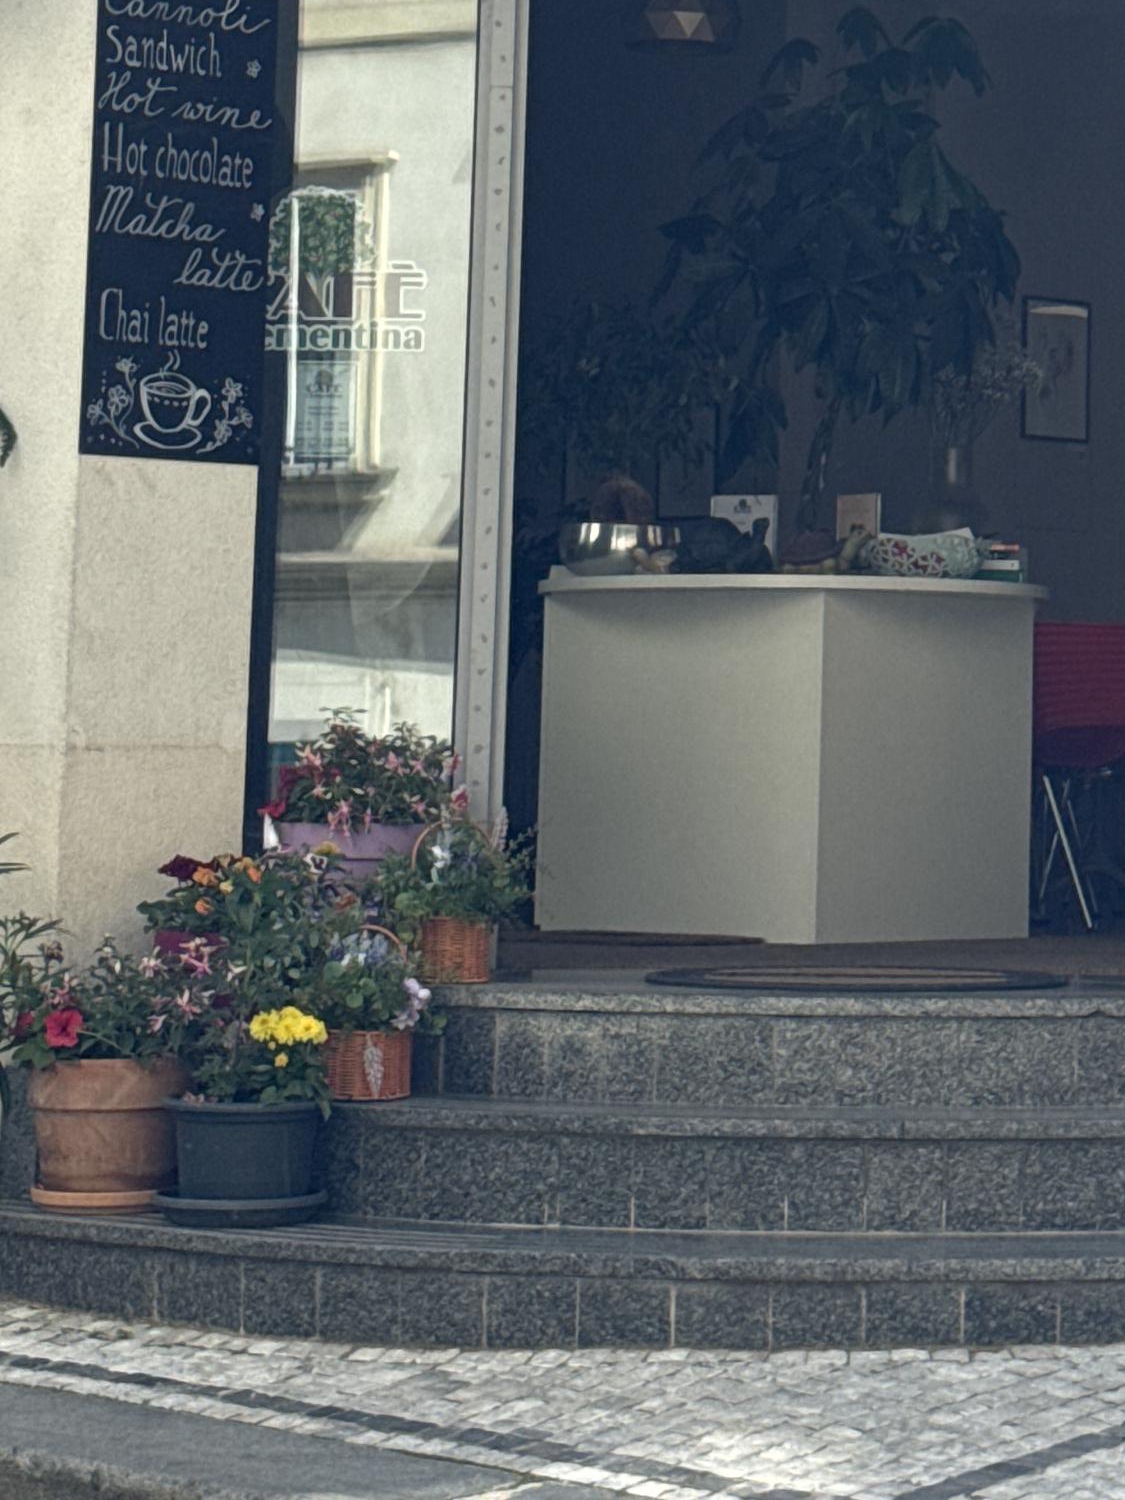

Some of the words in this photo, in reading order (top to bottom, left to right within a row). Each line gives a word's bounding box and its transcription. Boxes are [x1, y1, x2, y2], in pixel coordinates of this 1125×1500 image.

[105, 25, 222, 78] Sandwich
[98, 70, 178, 116] Hot
[171, 97, 273, 130] wine
[102, 121, 149, 176] Hot
[155, 132, 254, 189] chocolate
[95, 184, 227, 242] Matcha
[173, 247, 265, 292] latte
[268, 259, 425, 320] AFÉ
[99, 287, 150, 345] Chai
[158, 295, 209, 349] latte
